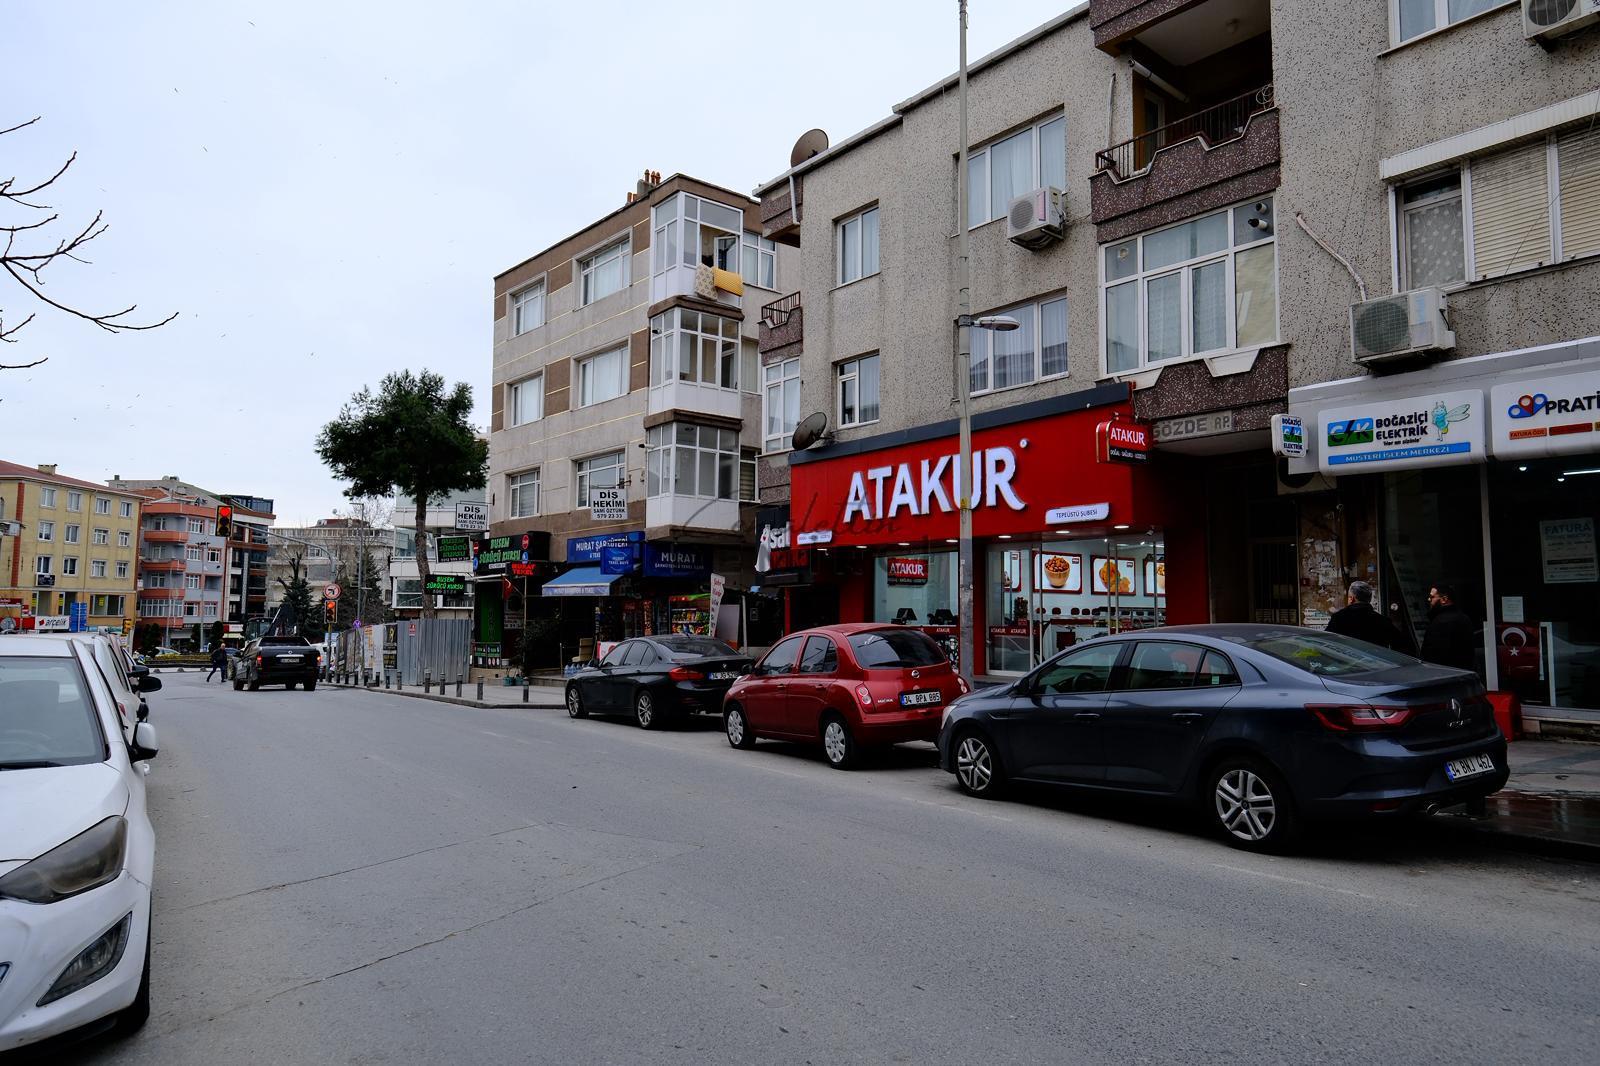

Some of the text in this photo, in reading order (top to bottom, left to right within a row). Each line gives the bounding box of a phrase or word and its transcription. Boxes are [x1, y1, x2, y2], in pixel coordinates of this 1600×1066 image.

[1375, 410, 1428, 428] BOĞAZİÇİ
[1110, 427, 1146, 446] ATAKUR
[1375, 426, 1428, 441] ELEKTRİK
[843, 446, 1027, 523] ATAKUR
[600, 490, 618, 499] DİŞ
[464, 504, 480, 513] DİŞ
[593, 499, 625, 508] HEKİMİ
[1544, 522, 1592, 535] FATURA
[576, 541, 594, 551] MURAT
[661, 552, 696, 563] MURAT
[890, 563, 924, 576] ATAKUR
[1448, 762, 1460, 776] 34
[1476, 755, 1492, 770] 462
